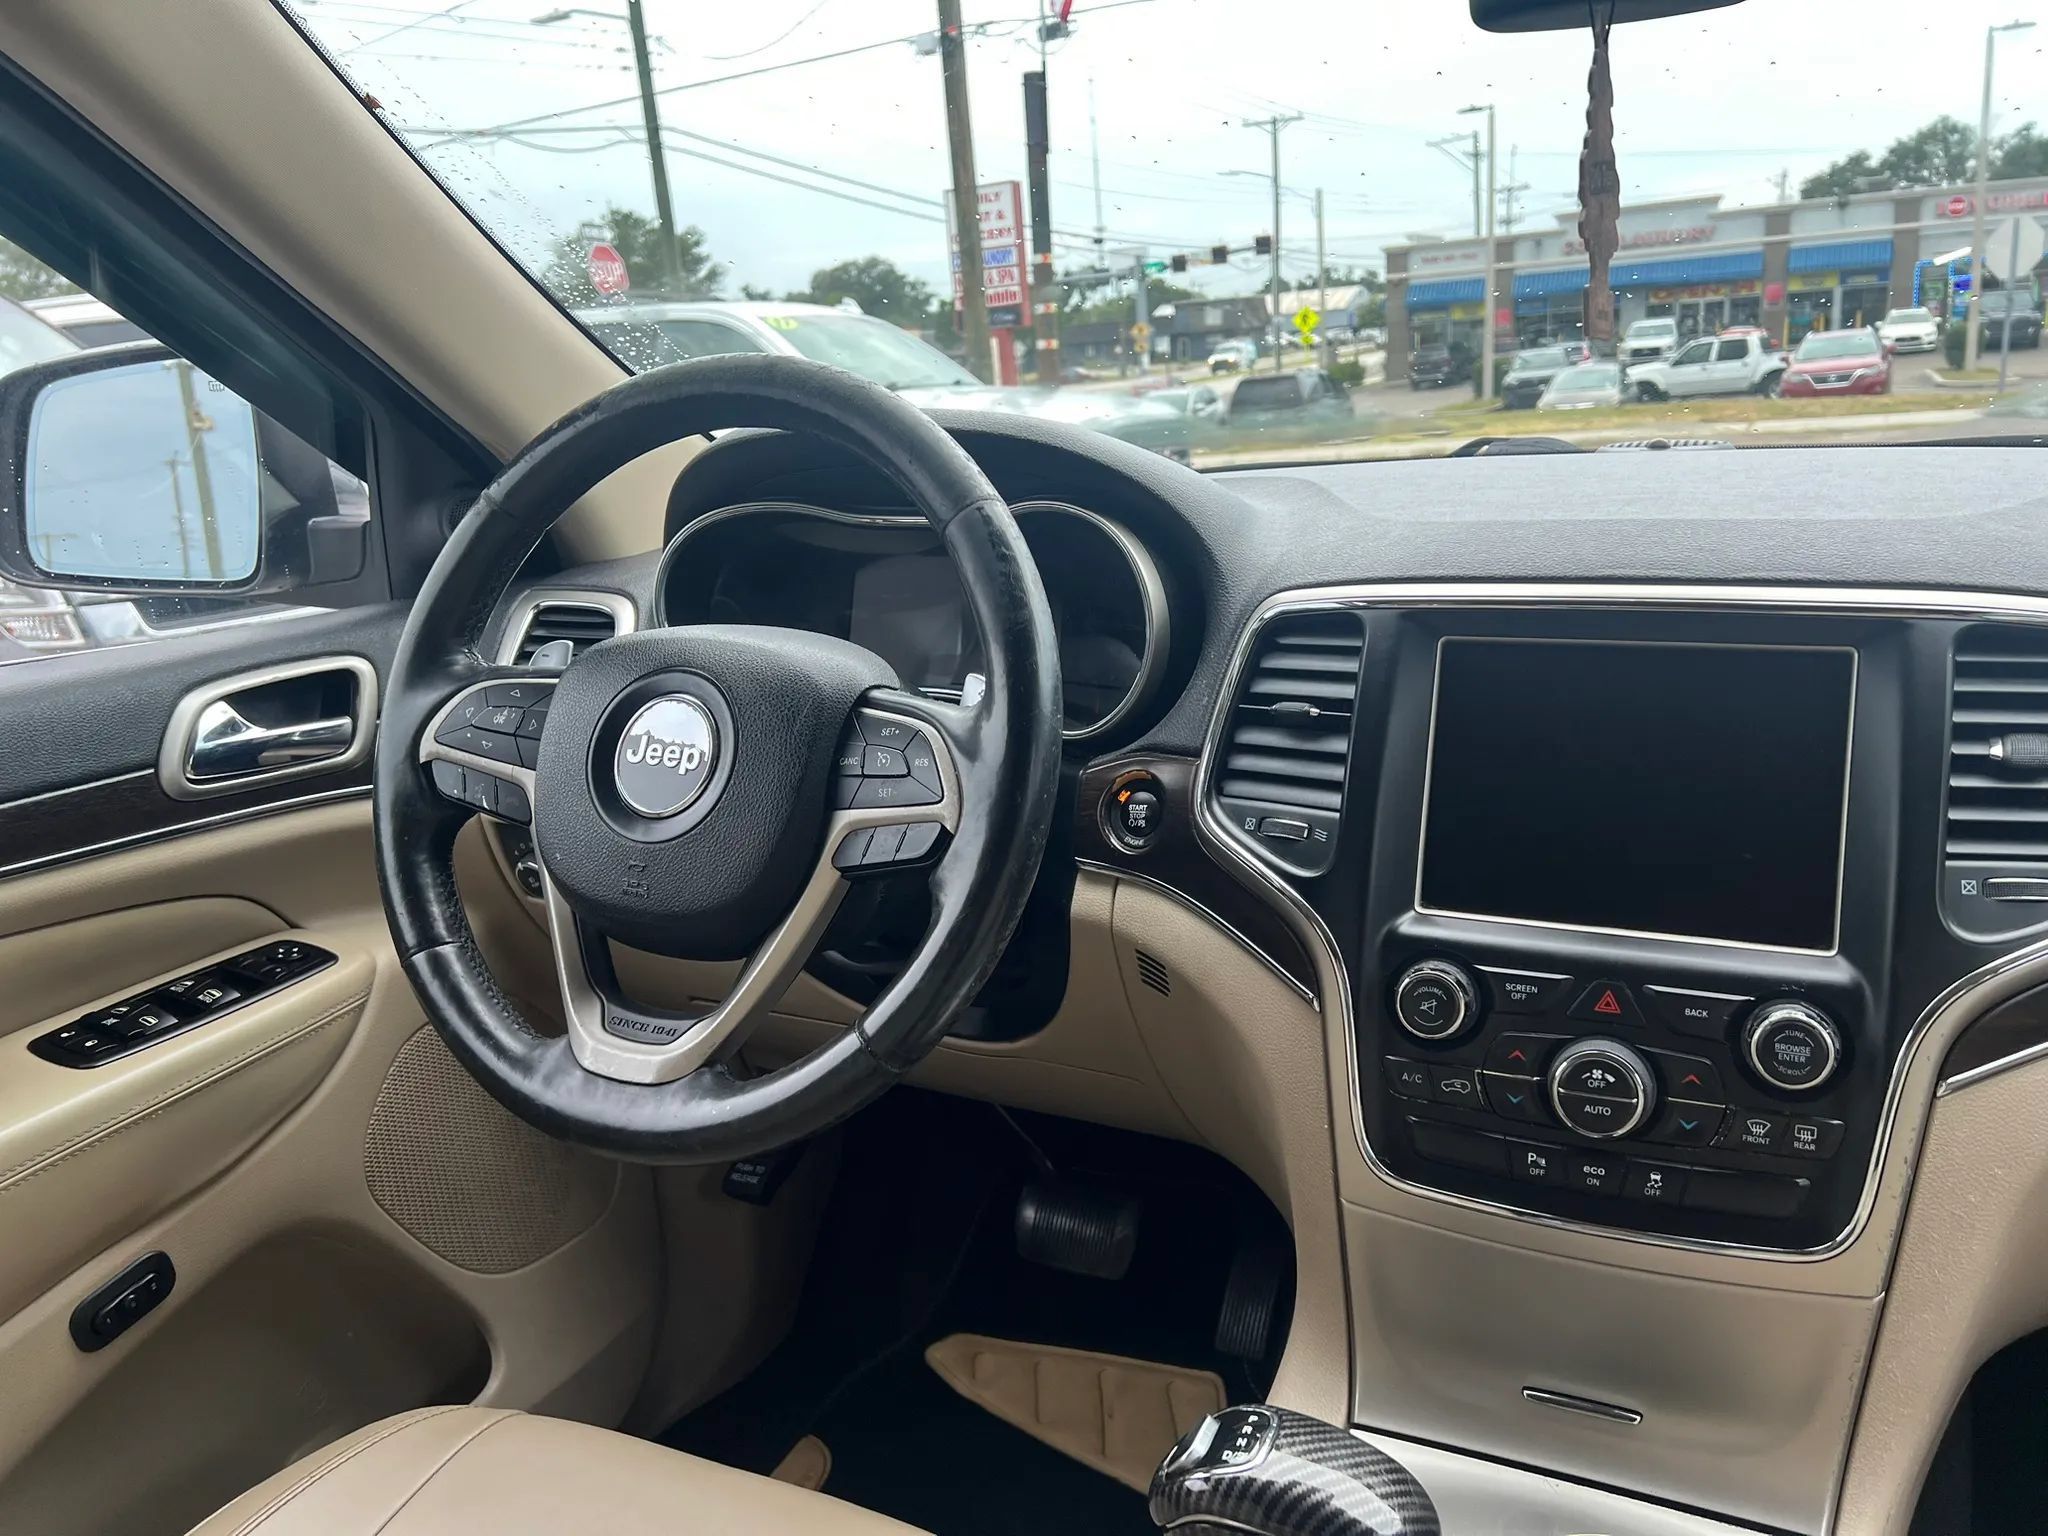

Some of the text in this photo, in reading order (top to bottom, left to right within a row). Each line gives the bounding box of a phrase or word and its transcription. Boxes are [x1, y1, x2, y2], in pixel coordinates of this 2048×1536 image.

[880, 727, 900, 736] SET+
[626, 734, 701, 775] Jeep
[914, 758, 929, 767] RES
[1123, 836, 1145, 846] ENGINE
[1417, 986, 1443, 996] VOLUME
[1505, 982, 1538, 994] SCREEN
[1510, 992, 1528, 1001] OFF
[1684, 1007, 1709, 1018] BACK
[608, 1015, 678, 1038] SINCE 1941
[1785, 1029, 1805, 1039] TUNE
[1774, 1042, 1812, 1055] BROWSE
[1778, 1053, 1806, 1064] ENTER
[1401, 1072, 1423, 1083] A/C
[1587, 1079, 1607, 1089] OFF
[1583, 1104, 1612, 1116] AUTO
[1742, 1134, 1771, 1145] FRONT
[1793, 1141, 1816, 1151] REAR
[1529, 1167, 1546, 1177] OFF
[1582, 1165, 1606, 1176] eco
[1586, 1177, 1601, 1187] ON
[1643, 1187, 1662, 1197] OFF
[1247, 1415, 1259, 1423] P
[1242, 1425, 1253, 1434] R
[1236, 1437, 1247, 1447] N
